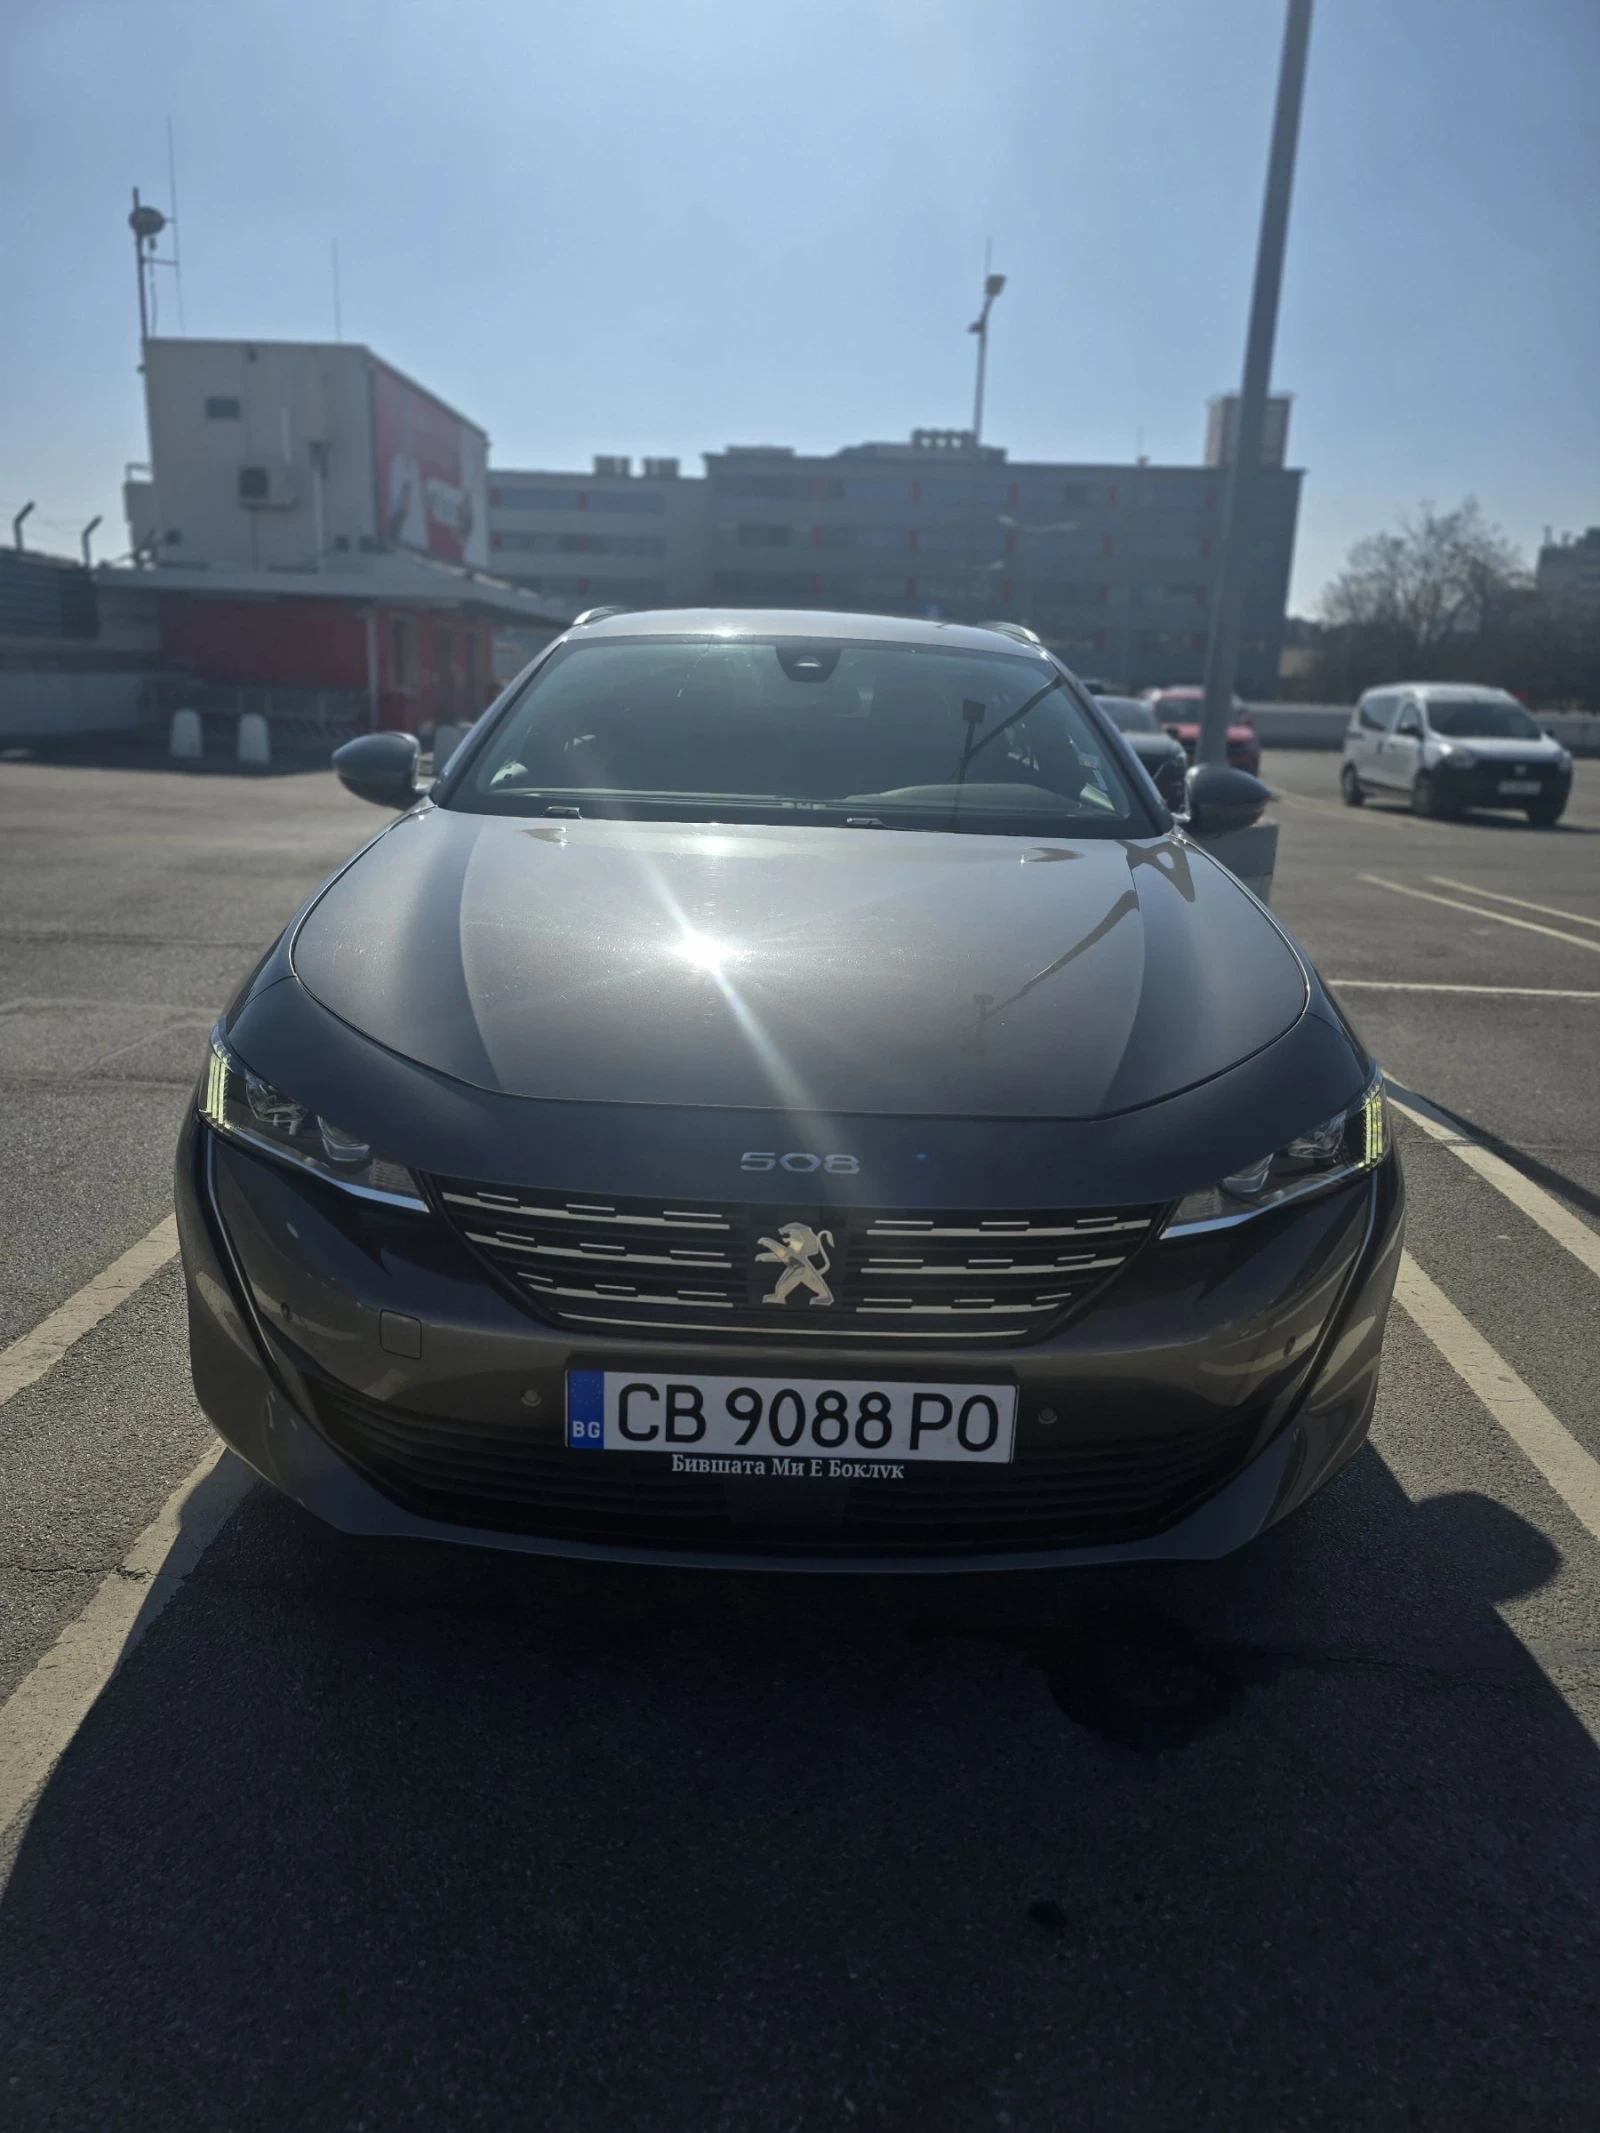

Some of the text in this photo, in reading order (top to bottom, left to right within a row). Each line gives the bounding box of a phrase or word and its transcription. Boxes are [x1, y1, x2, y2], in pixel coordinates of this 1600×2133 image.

[740, 1152, 860, 1174] 508
[618, 1382, 707, 1443] CB
[725, 1387, 893, 1450] 9088
[572, 1421, 600, 1438] BG
[671, 1454, 766, 1475] Бившата
[772, 1458, 804, 1476] Ми
[810, 1459, 824, 1477] Е
